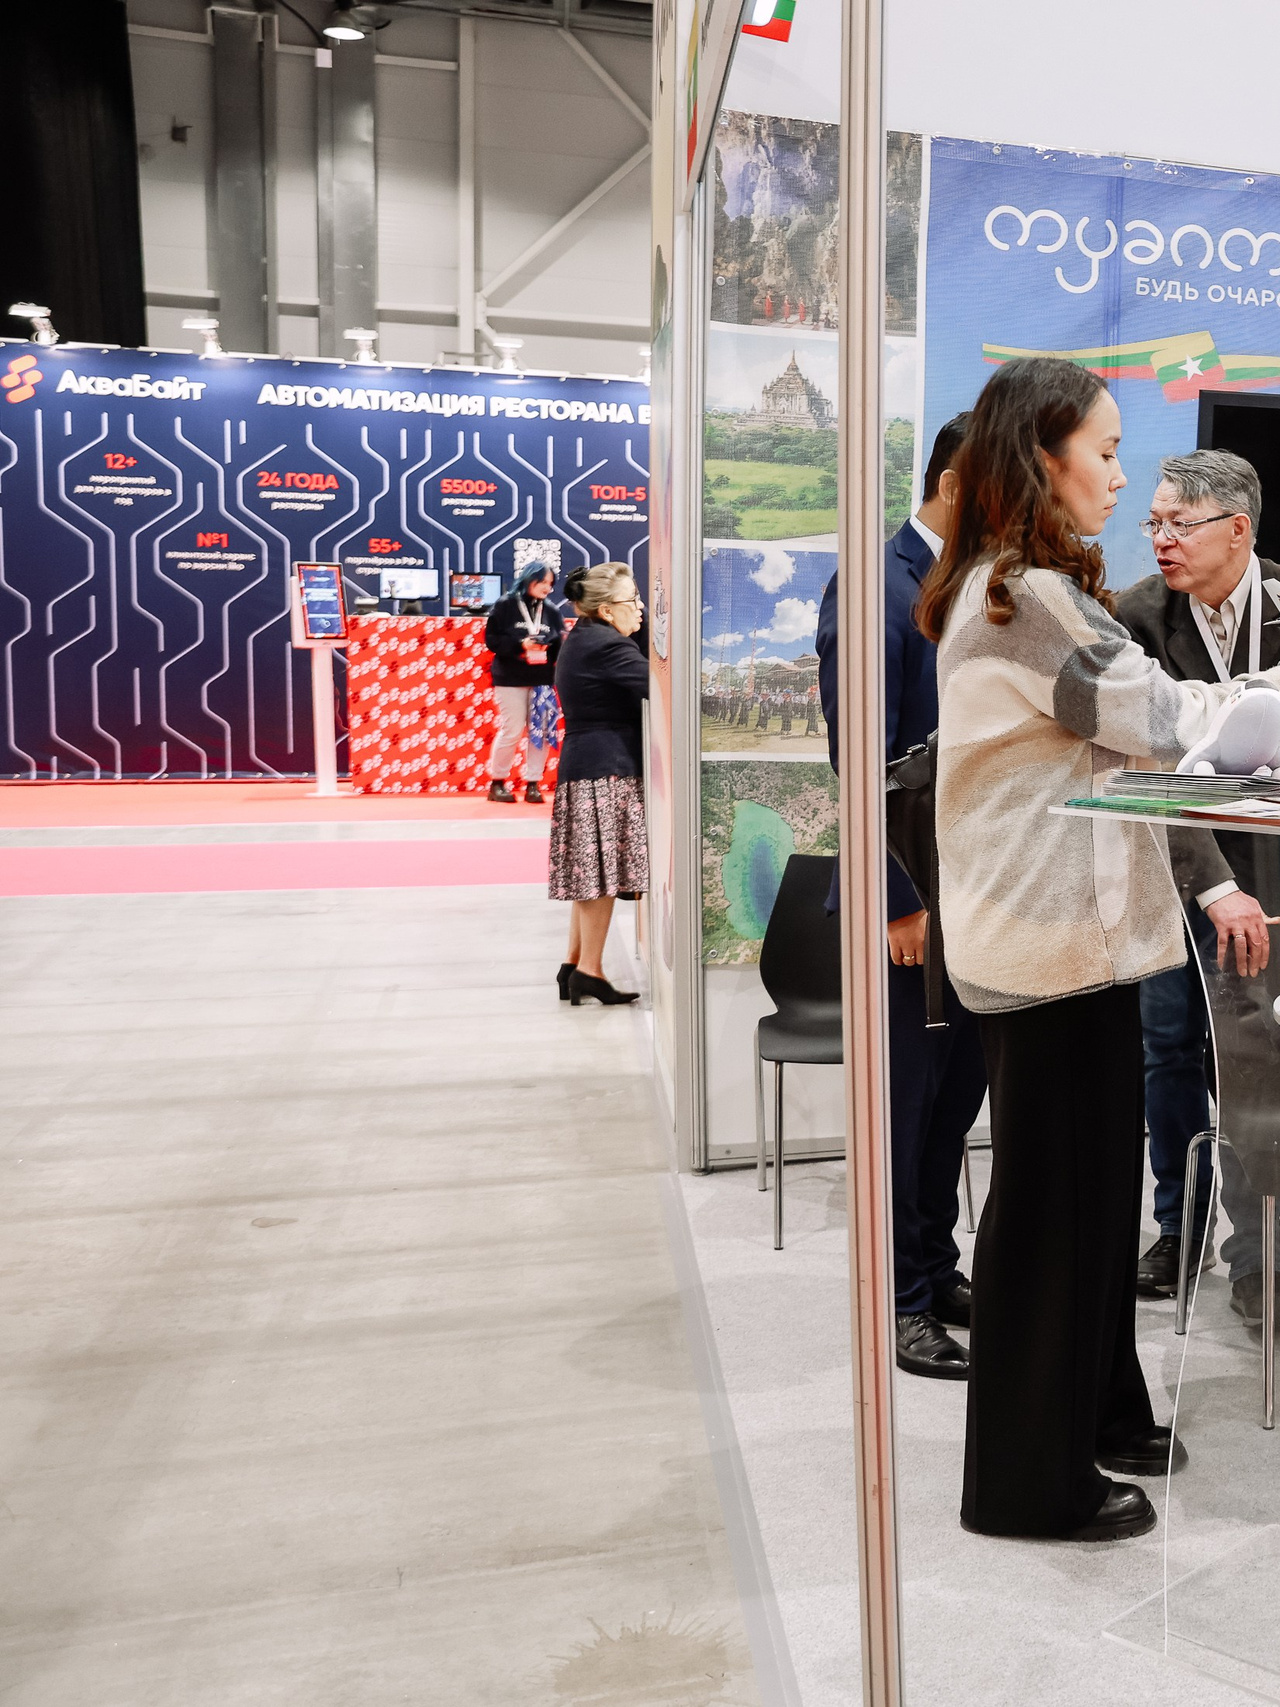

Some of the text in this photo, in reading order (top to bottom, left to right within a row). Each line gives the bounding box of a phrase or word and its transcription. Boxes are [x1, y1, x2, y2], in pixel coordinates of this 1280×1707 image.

[1135, 276, 1199, 303] БУДЬ
[56, 369, 207, 400] АкваБайт
[257, 383, 486, 418] АВТОМАТИЗАЦИЯ
[489, 396, 635, 424] РЕСТОРАНА
[103, 453, 138, 470] 12+
[256, 470, 340, 491] 24 ГОДА
[440, 478, 498, 495] 5500+
[196, 532, 229, 548] №1
[368, 538, 403, 554] 55+
